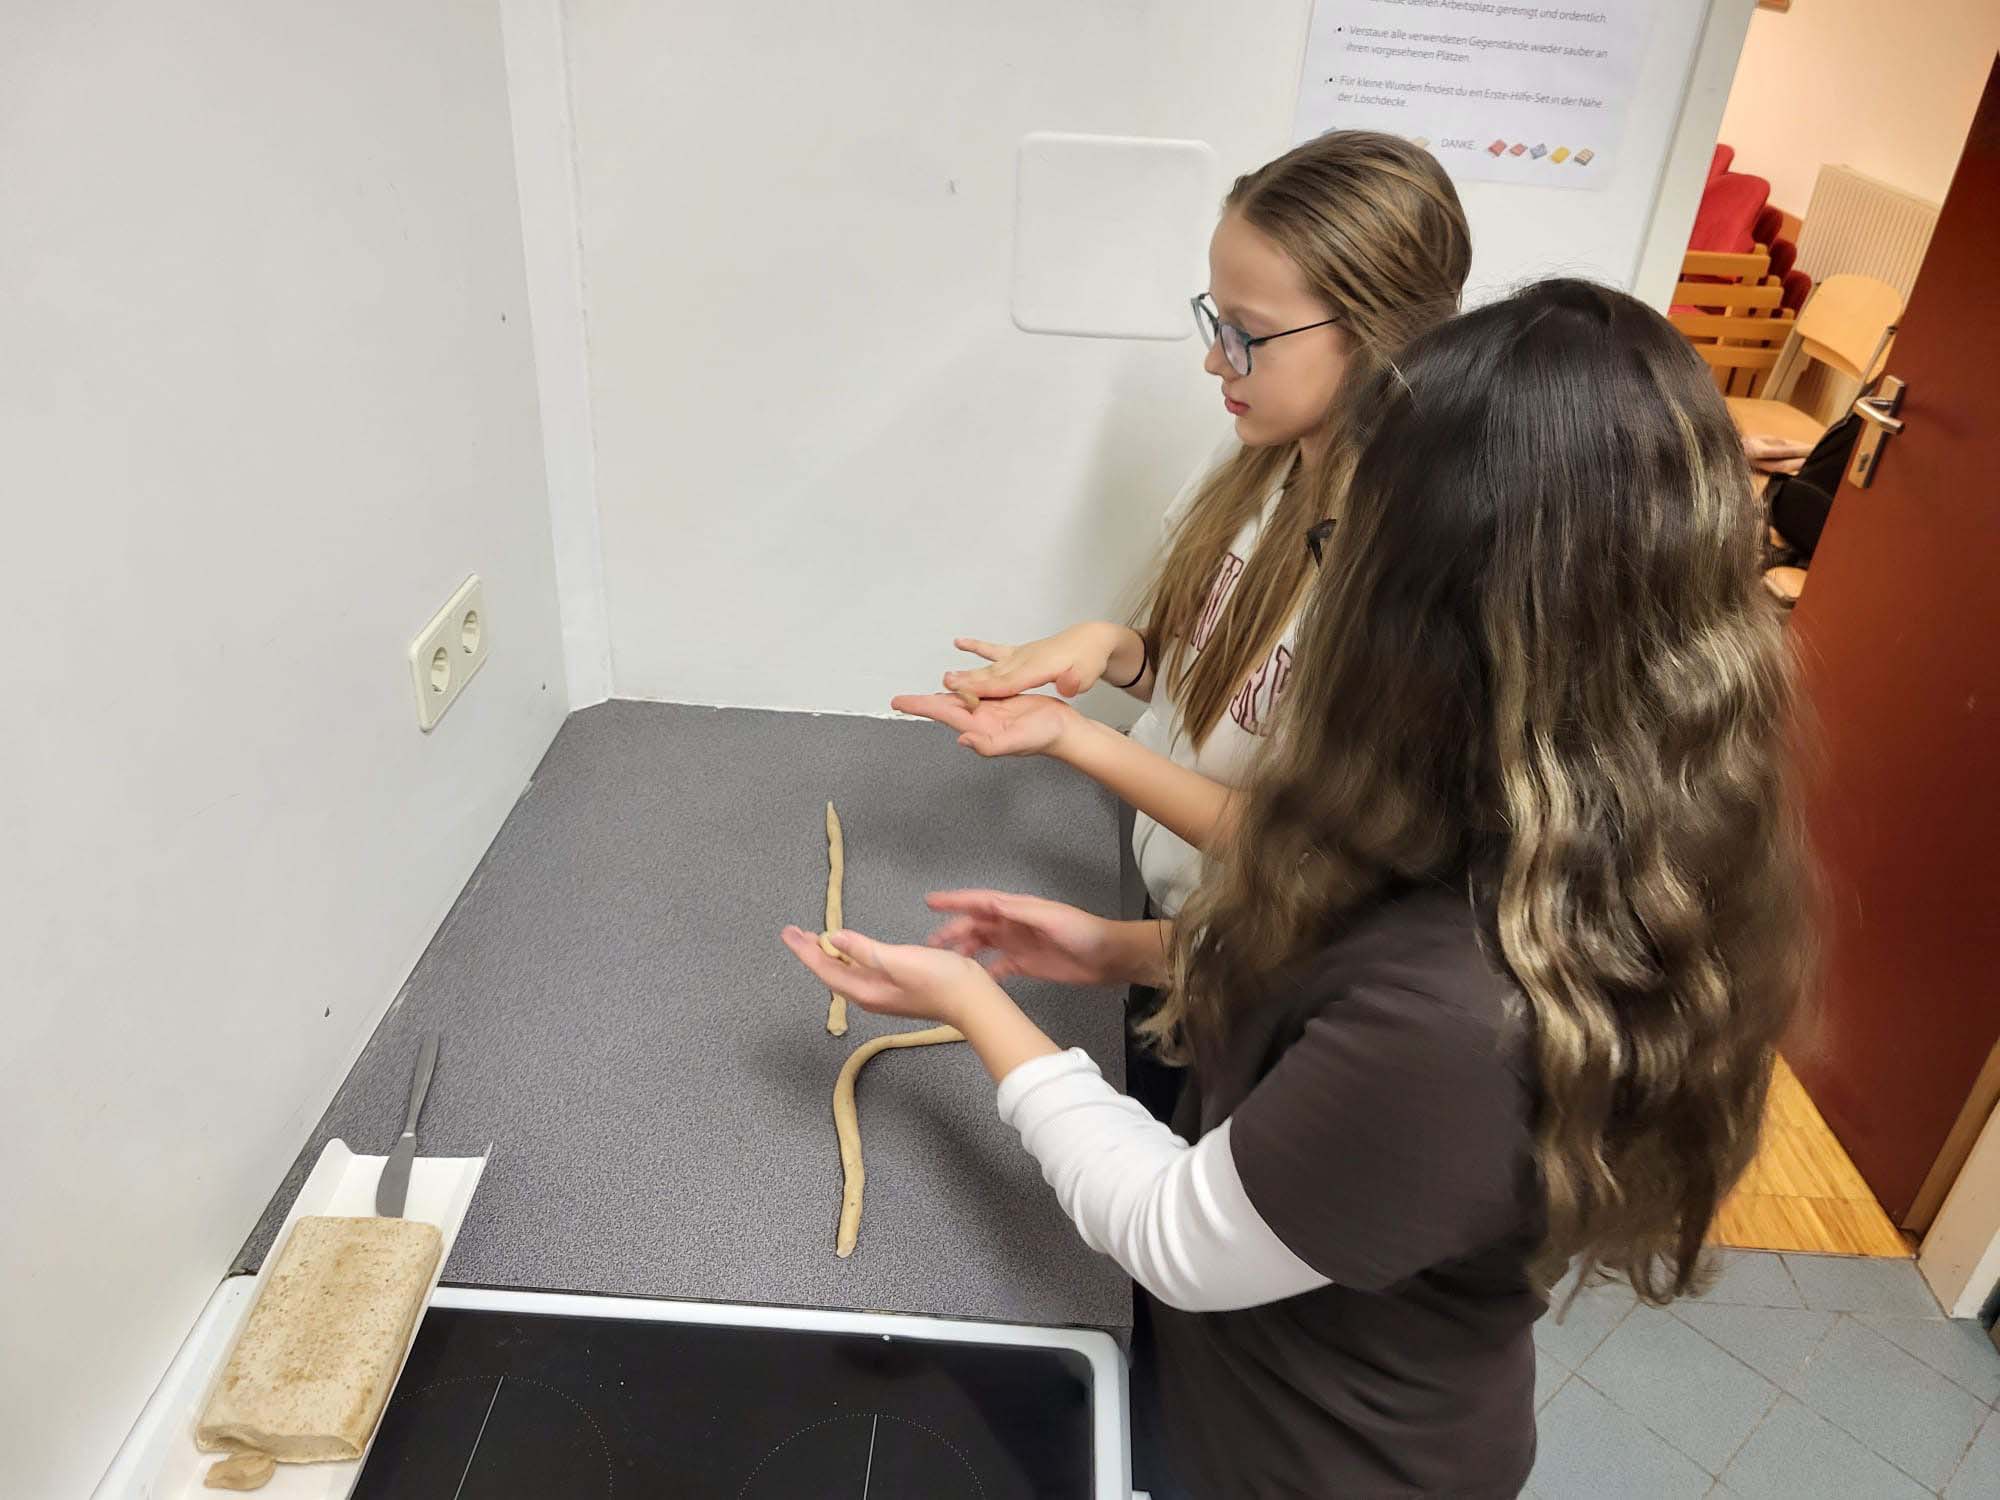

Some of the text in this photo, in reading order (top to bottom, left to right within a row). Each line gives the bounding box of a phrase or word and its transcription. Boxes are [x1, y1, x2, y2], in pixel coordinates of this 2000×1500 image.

[1441, 0, 1495, 13] Arbeitsplatz
[1496, 6, 1537, 19] gereinigt
[1540, 8, 1558, 19] und
[1346, 42, 1369, 53] ihren
[1372, 46, 1434, 59] vorgesehenen
[1349, 25, 1608, 58] Verstaue alle verwendeten Gegenstände wieder sauber an
[1338, 93, 1353, 103] der
[1358, 77, 1384, 89] kleine
[1385, 79, 1422, 92] Wunden
[1424, 82, 1454, 95] findest
[1455, 86, 1468, 97] du
[1469, 88, 1483, 98] ein
[1484, 89, 1549, 105] Erste-Hilfe-Set
[1550, 95, 1560, 105] in
[1561, 96, 1578, 107] der
